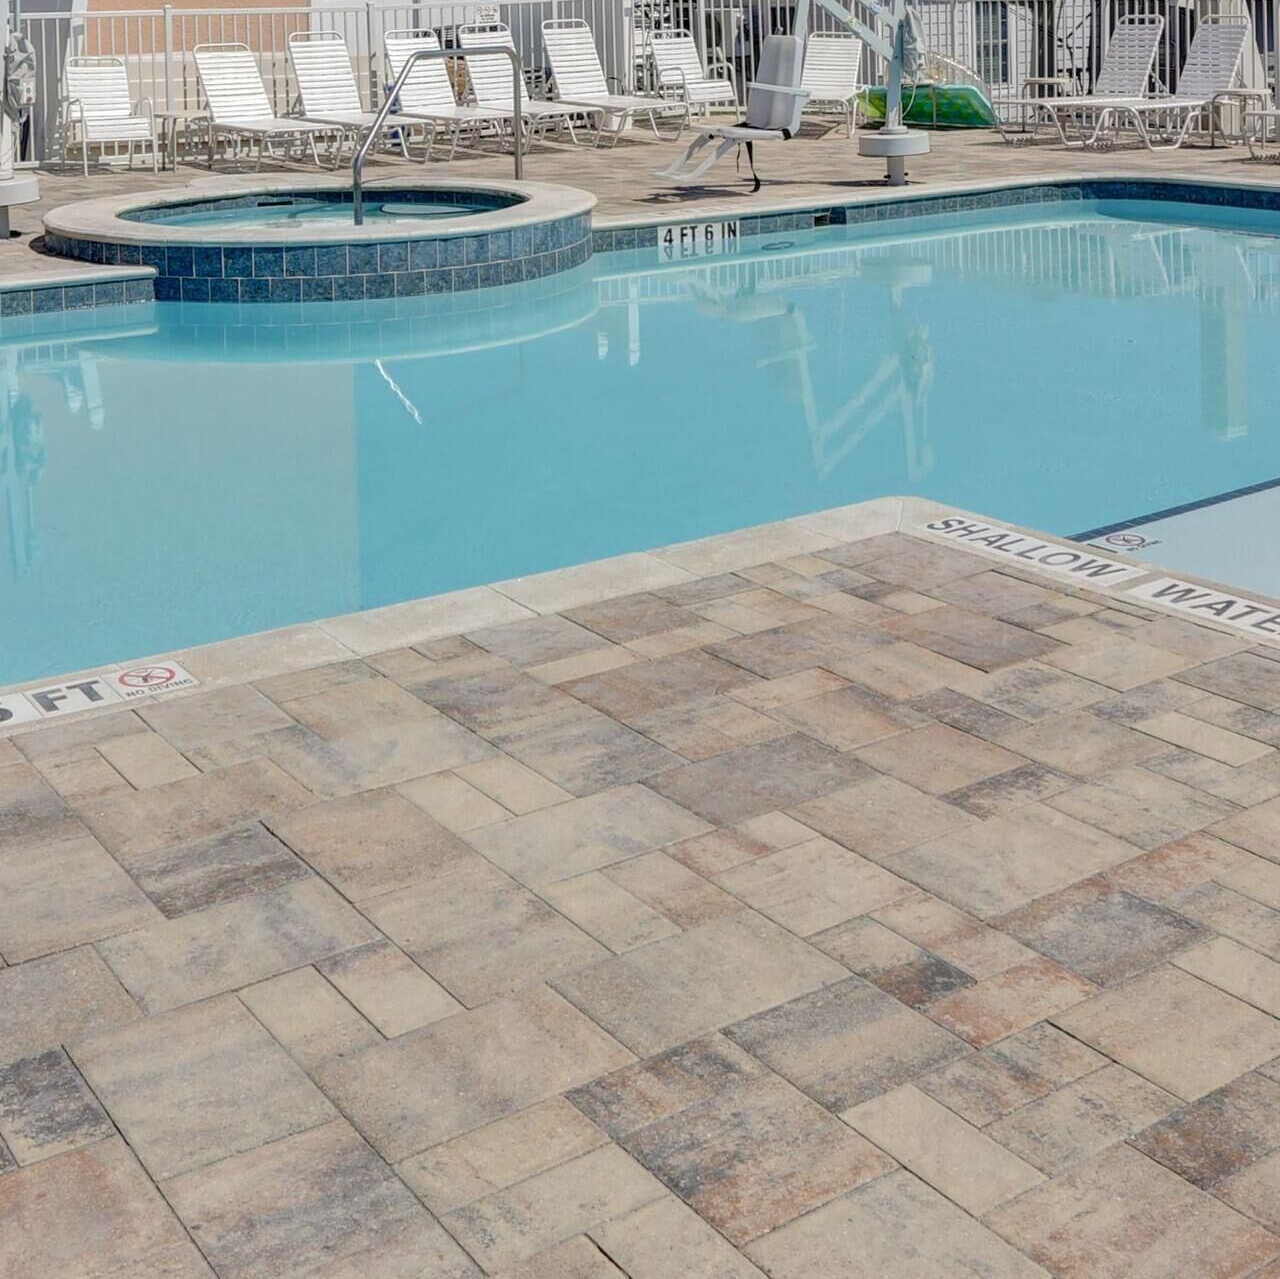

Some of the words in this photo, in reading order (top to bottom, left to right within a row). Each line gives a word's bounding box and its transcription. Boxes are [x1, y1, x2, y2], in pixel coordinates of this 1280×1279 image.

[663, 228, 674, 244] 4
[680, 226, 698, 242] FT
[705, 224, 714, 240] 6
[721, 222, 737, 238] IN
[927, 518, 1127, 579] SHALLOW
[31, 680, 108, 712] FT
[125, 689, 145, 697] NO
[149, 678, 193, 692] DIVING
